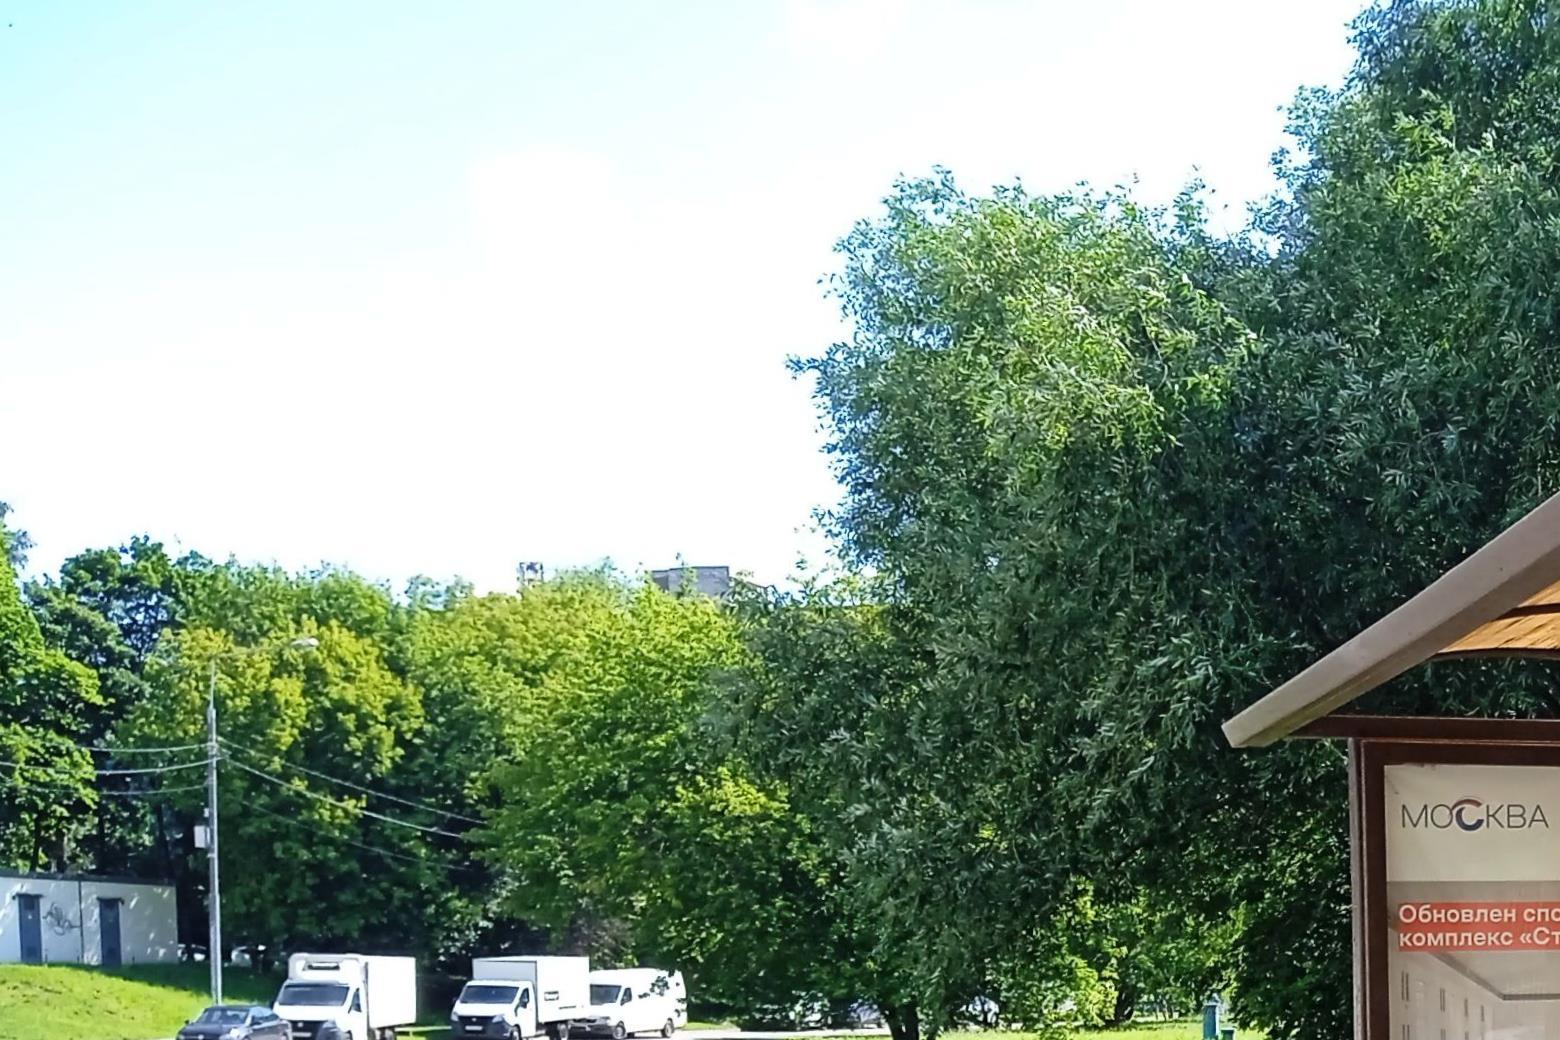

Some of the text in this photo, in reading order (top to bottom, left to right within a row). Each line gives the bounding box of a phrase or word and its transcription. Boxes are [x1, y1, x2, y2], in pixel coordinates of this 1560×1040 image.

[1401, 798, 1550, 832] МОСКВА
[1399, 904, 1517, 924] Обновлен
[1399, 930, 1513, 947] комплекс
